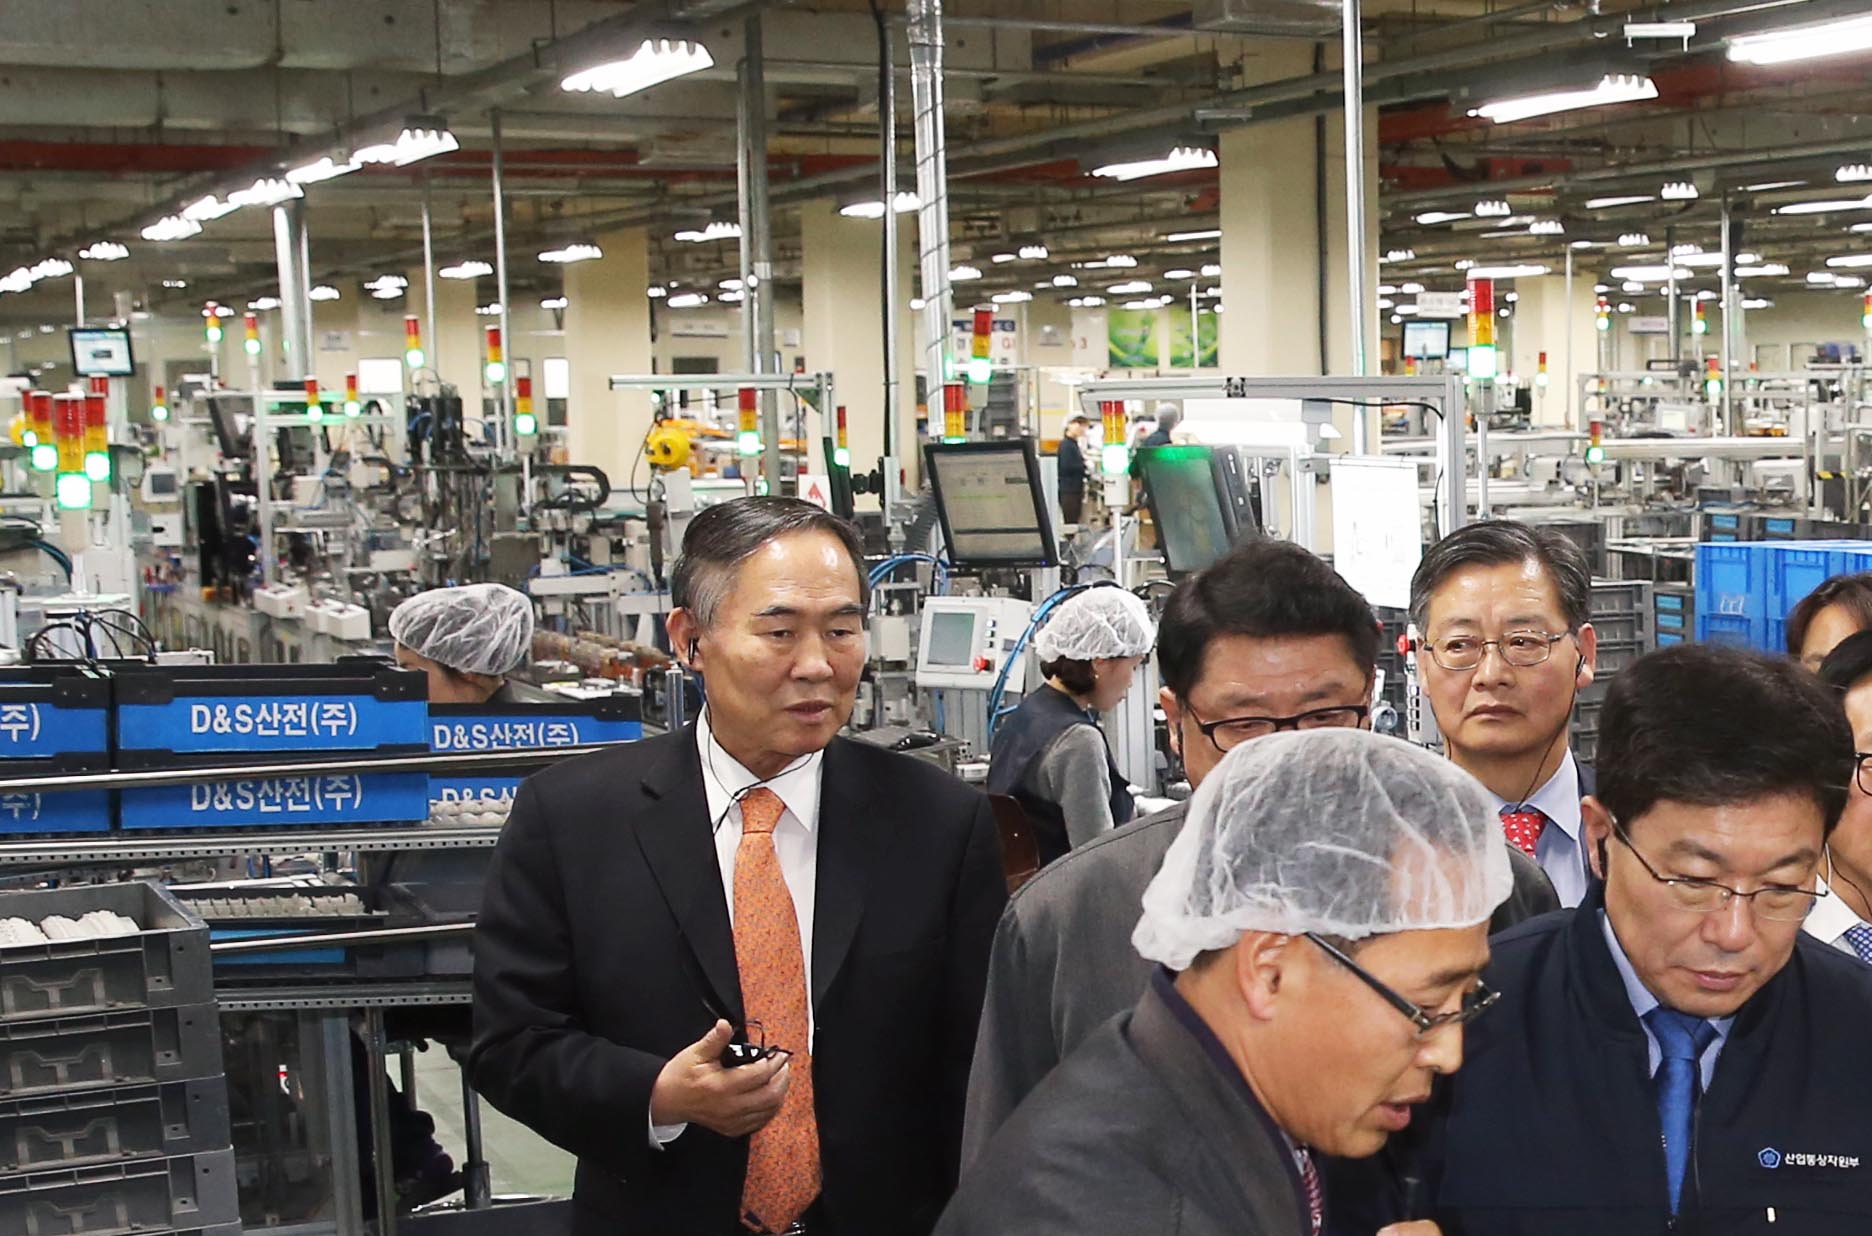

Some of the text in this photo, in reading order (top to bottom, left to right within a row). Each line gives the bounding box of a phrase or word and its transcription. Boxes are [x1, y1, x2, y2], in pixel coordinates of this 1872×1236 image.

[191, 702, 357, 737] D&S산전(주)
[191, 774, 362, 812] D&S산전(주)
[1784, 1153, 1860, 1168] 산업통상자원부
